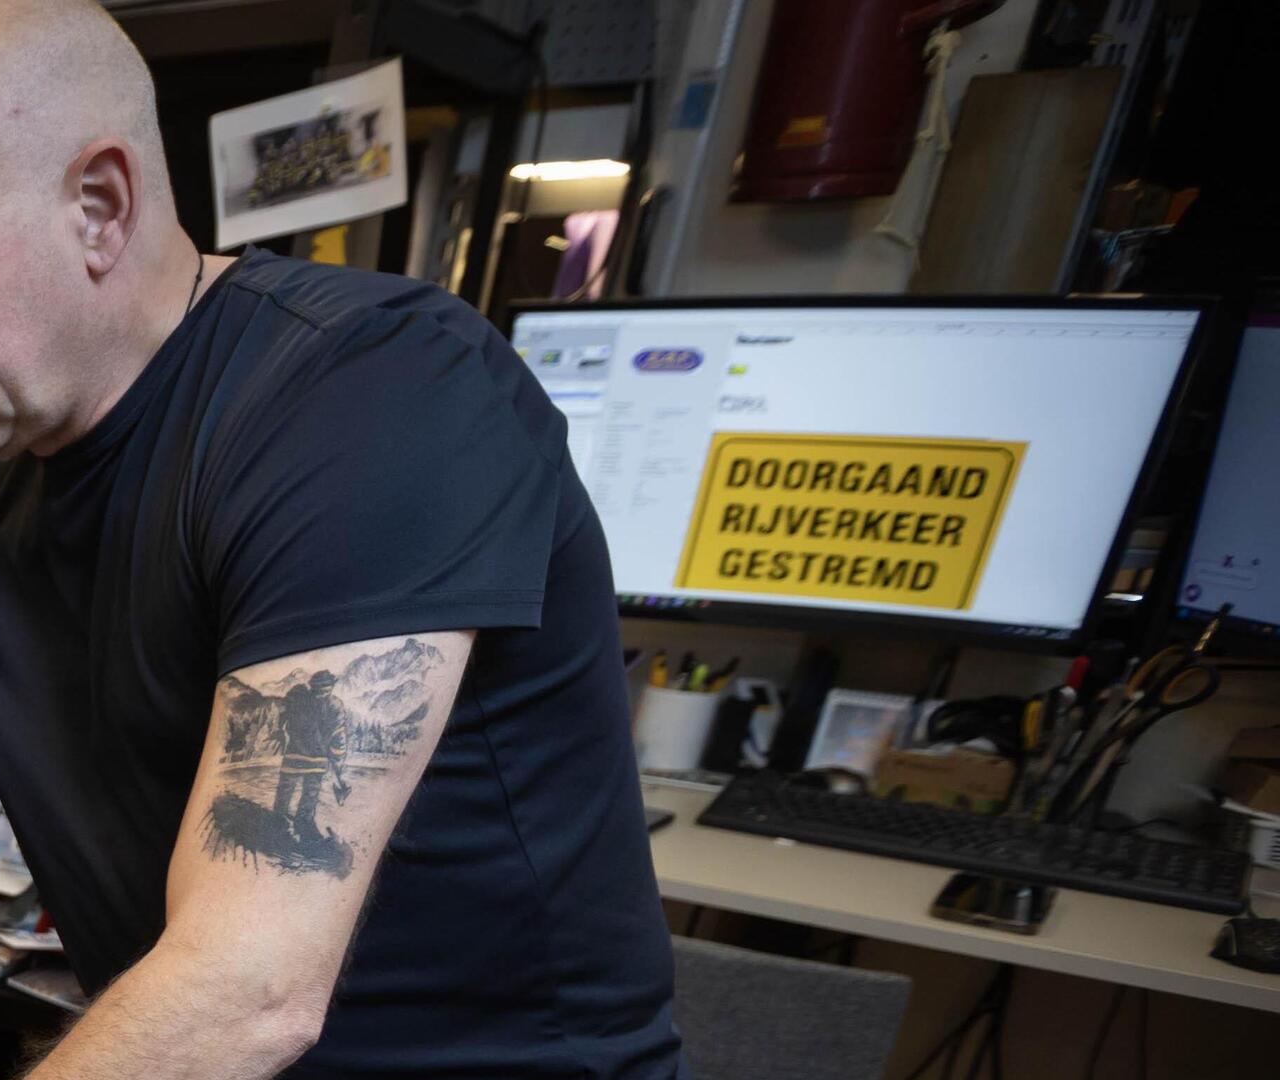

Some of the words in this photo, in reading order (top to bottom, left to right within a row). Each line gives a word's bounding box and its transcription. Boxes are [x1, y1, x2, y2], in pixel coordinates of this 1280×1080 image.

[725, 457, 989, 500] DOORGAAND
[719, 503, 967, 547] RIJVERKEER
[718, 547, 940, 592] GESTREMD
